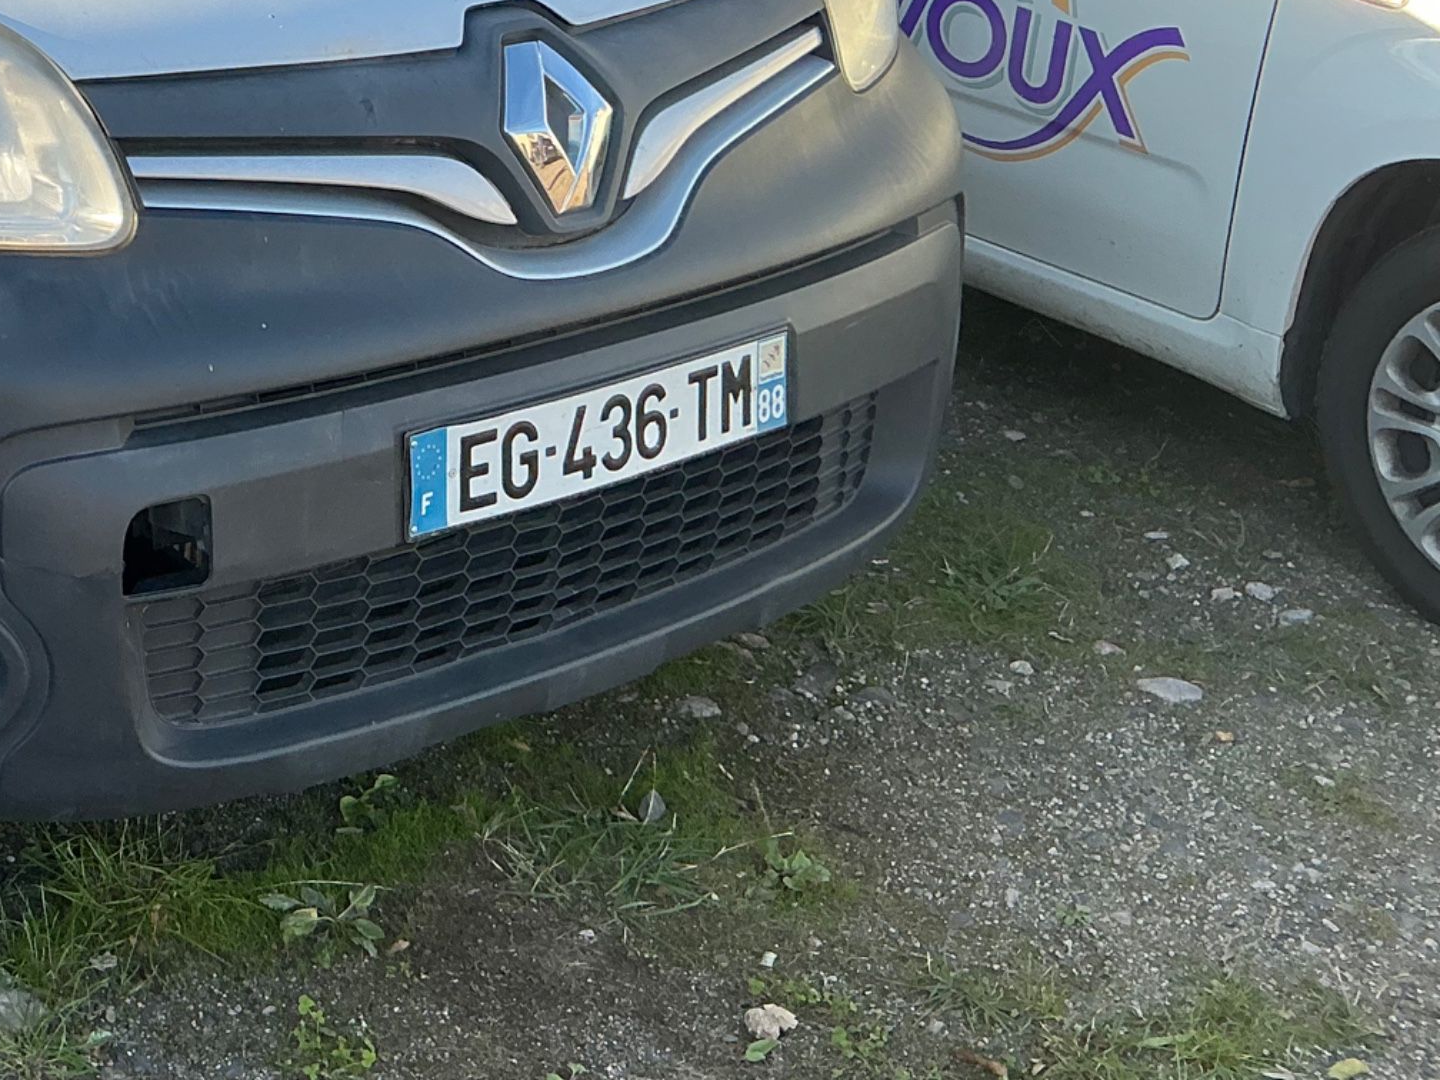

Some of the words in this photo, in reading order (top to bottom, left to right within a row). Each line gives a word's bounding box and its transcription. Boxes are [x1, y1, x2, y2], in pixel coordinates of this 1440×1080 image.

[758, 383, 785, 424] 88
[458, 353, 753, 513] EG-436-TM
[419, 491, 433, 517] F
